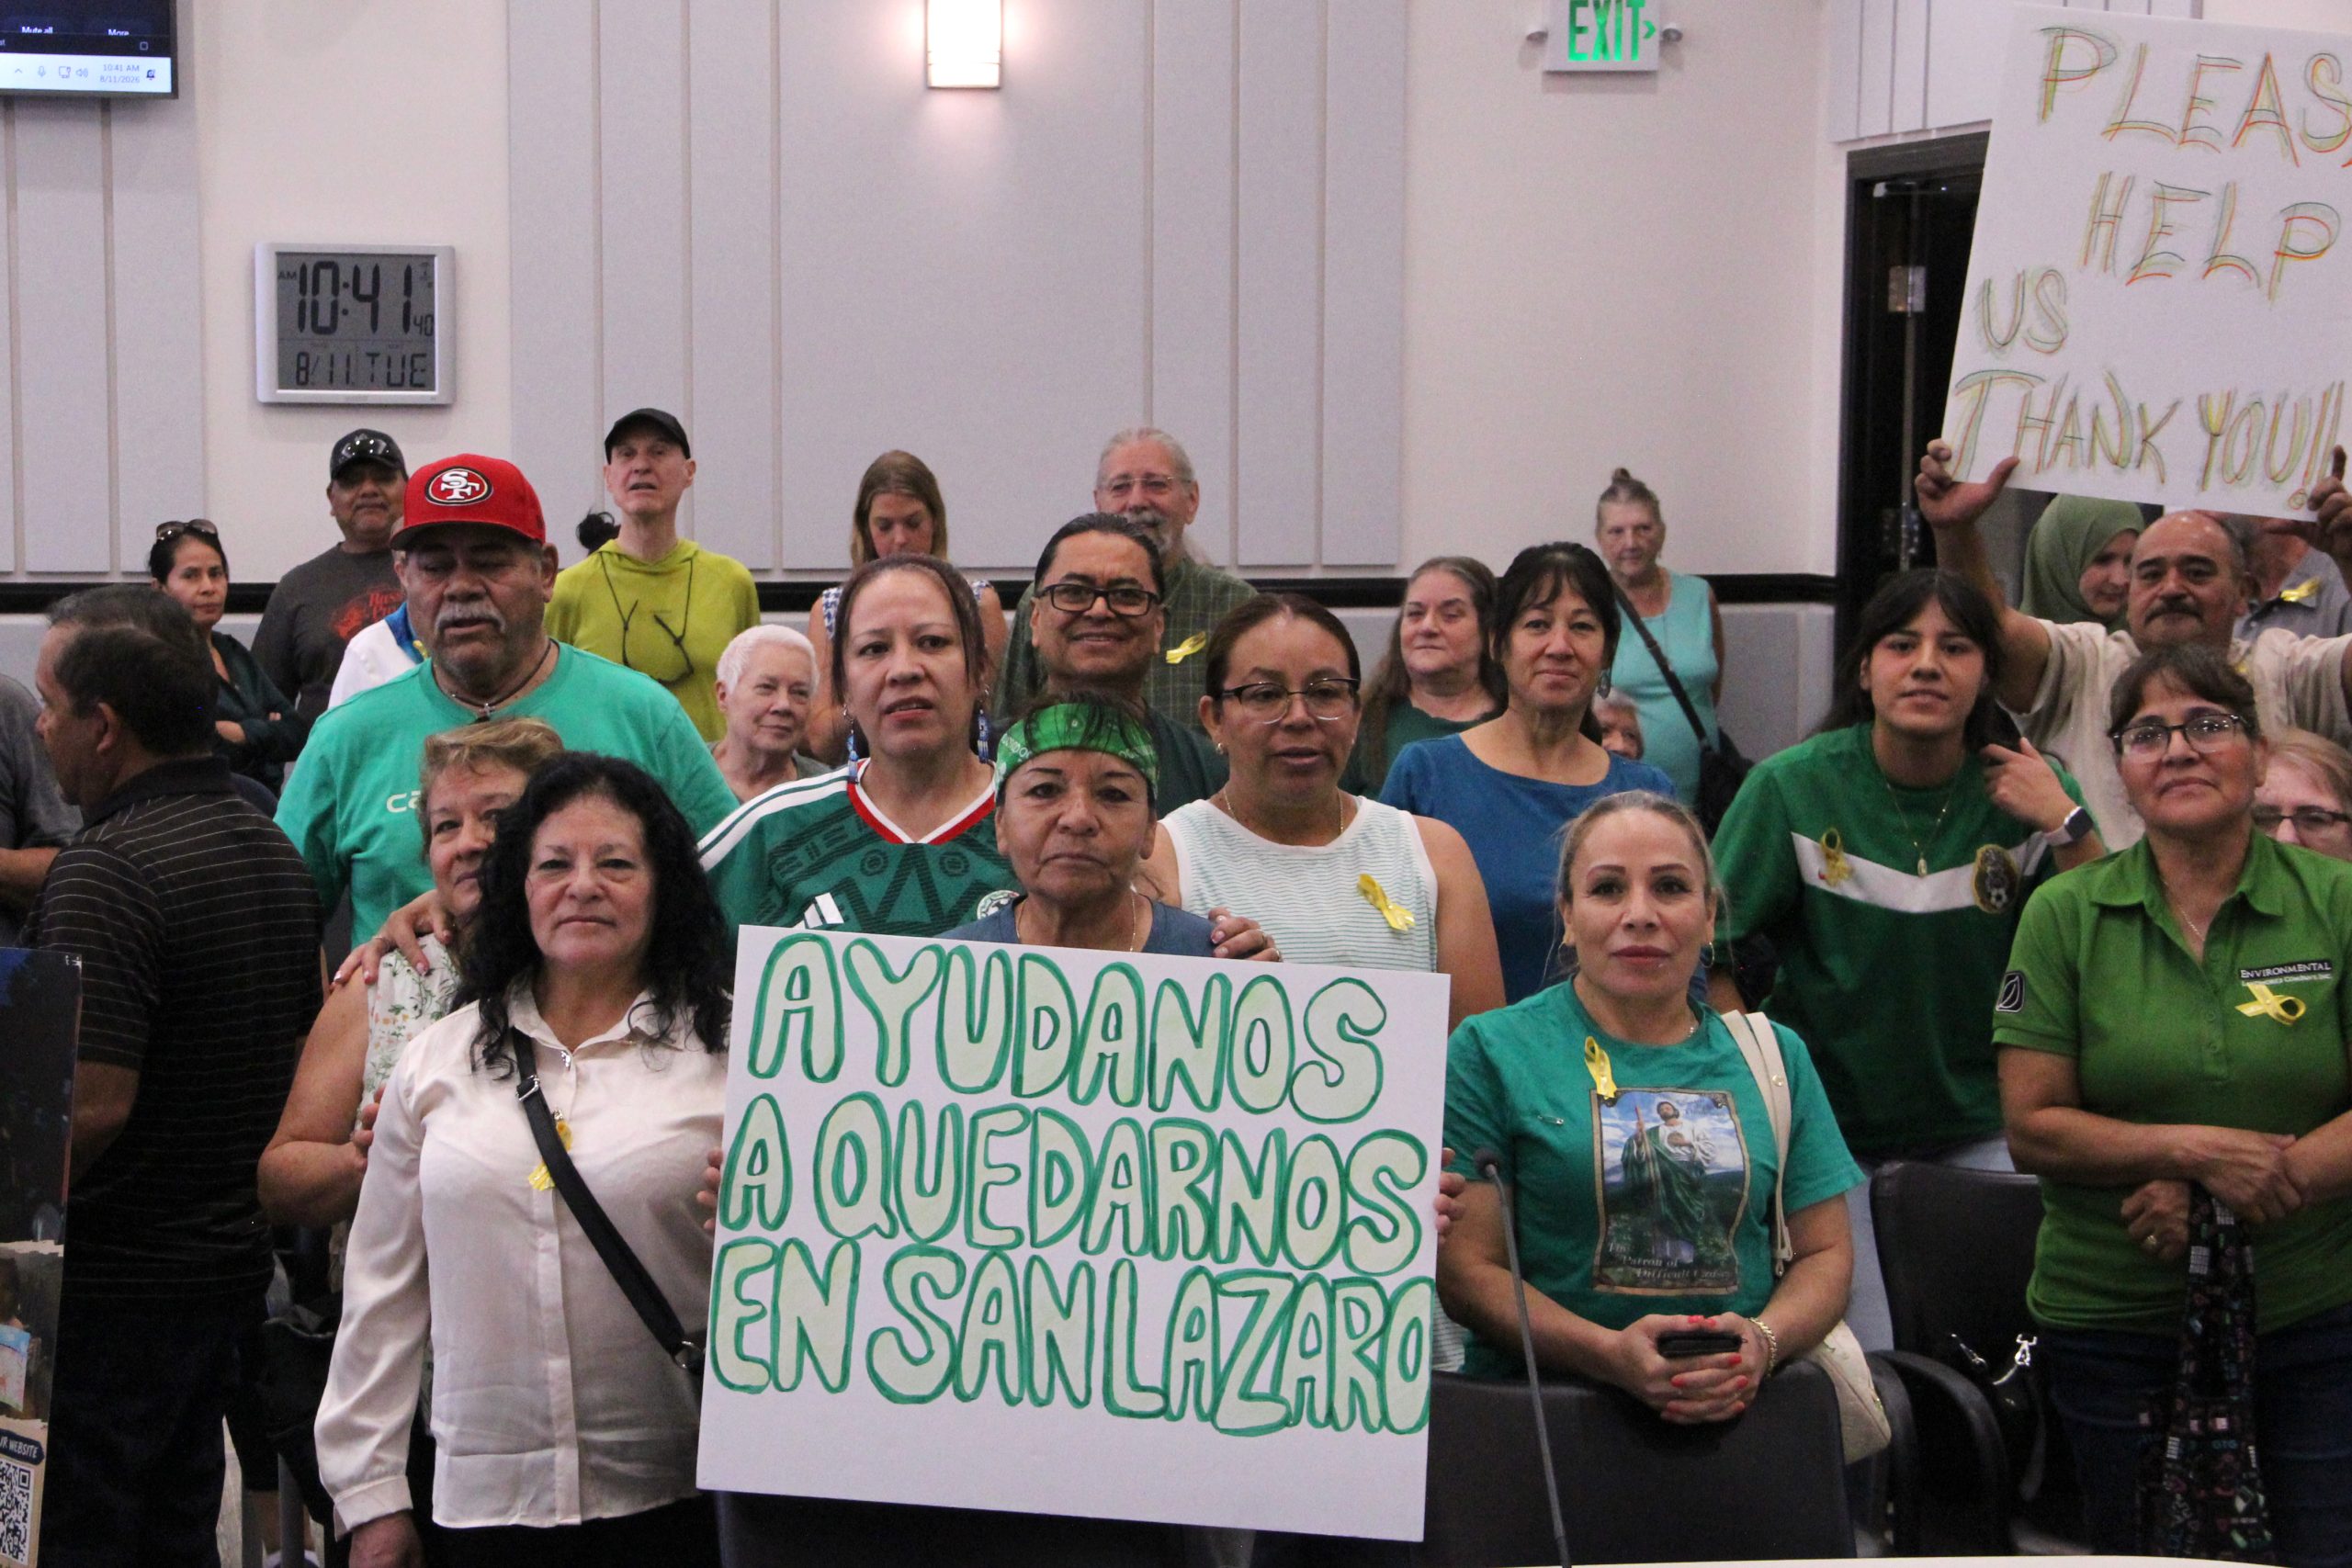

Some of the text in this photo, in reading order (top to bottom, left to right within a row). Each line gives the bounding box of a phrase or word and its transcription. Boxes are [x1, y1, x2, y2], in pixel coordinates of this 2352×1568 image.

[1568, 0, 1645, 62] EXIT
[2037, 27, 2352, 167] PLEAS
[2078, 171, 2341, 305] HELP
[298, 260, 413, 335] 10:41
[1975, 269, 2069, 355] US
[295, 351, 428, 389] 8/11 TUE
[1955, 369, 2182, 485] THANK
[440, 470, 480, 501] SF
[2240, 962, 2332, 979] ENVIRONMENTAL
[746, 932, 1387, 1124] AYUDANOS
[718, 1090, 1428, 1276] A QUEDARNOS
[708, 1236, 1437, 1438] EN SAN LAZARO
[9, 1439, 39, 1459] WEBSITE
